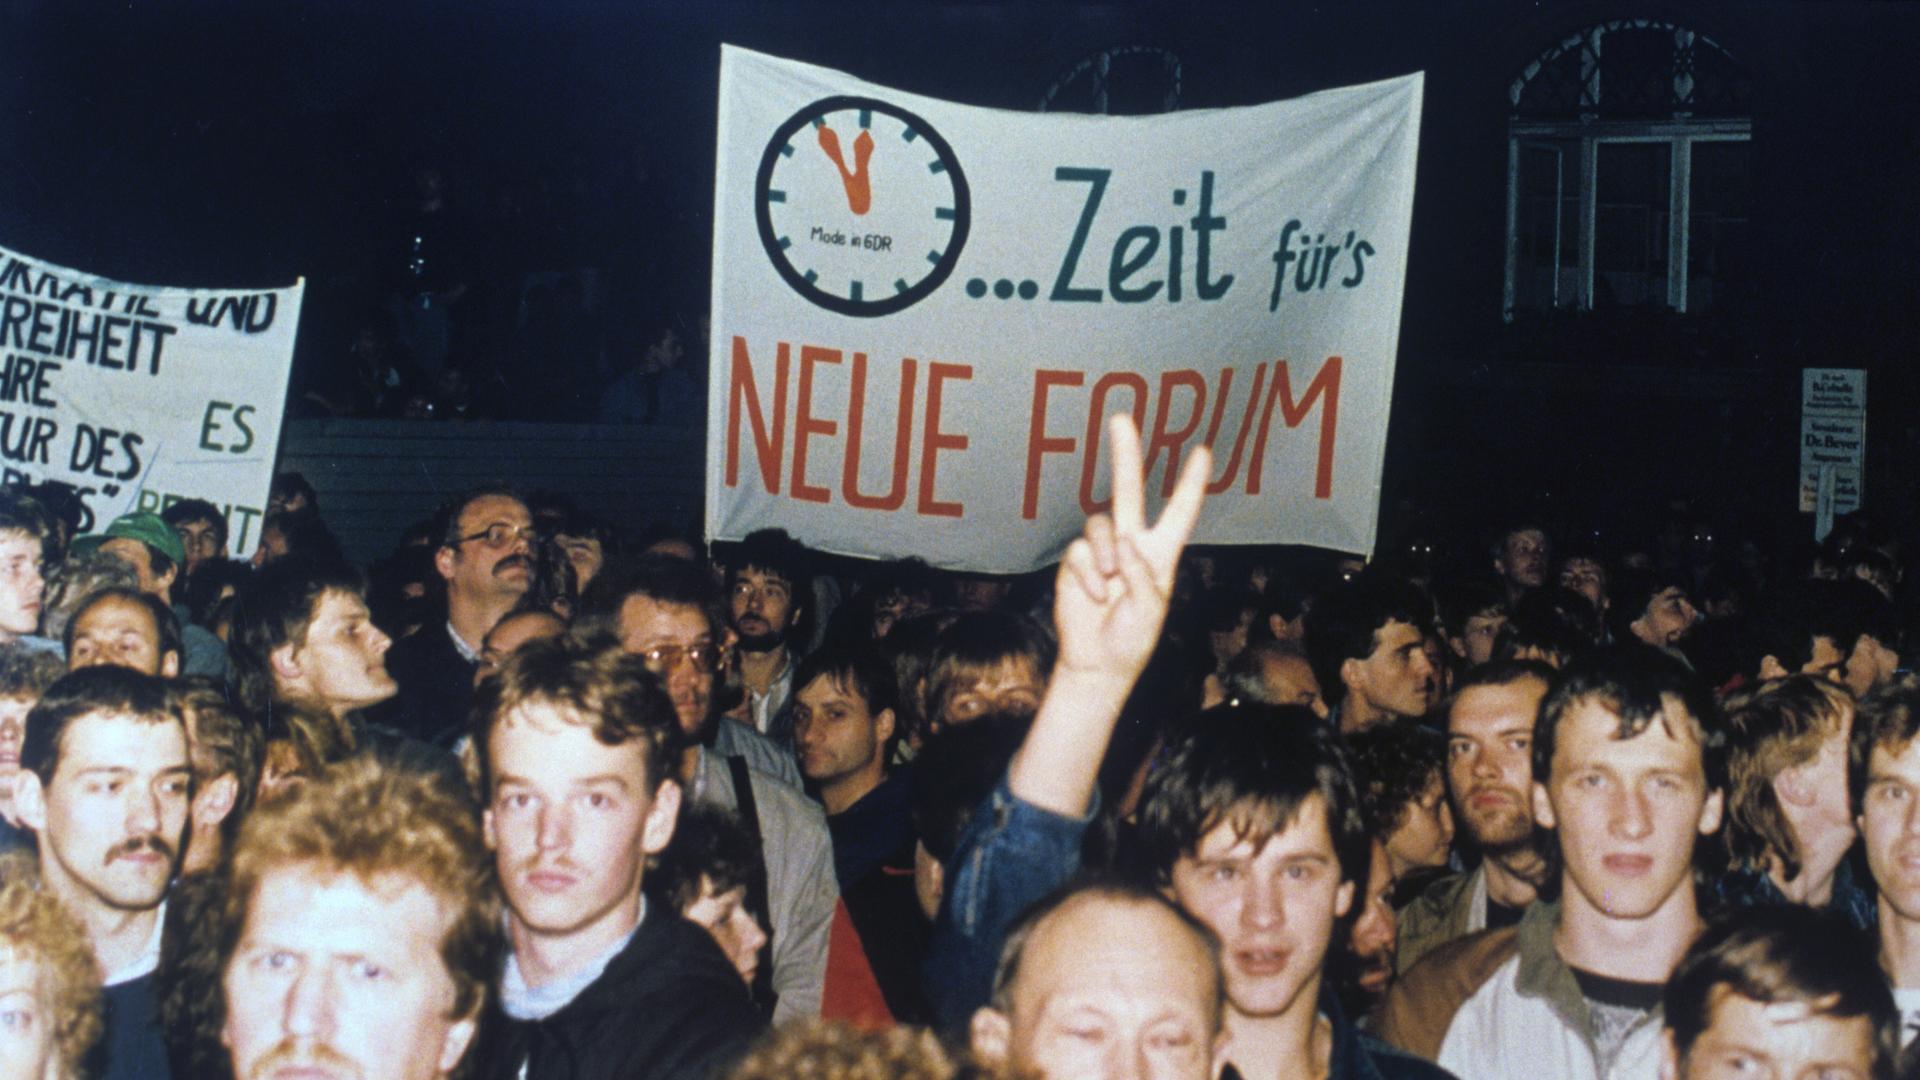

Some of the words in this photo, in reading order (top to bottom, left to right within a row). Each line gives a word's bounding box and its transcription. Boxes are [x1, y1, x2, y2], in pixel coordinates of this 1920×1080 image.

[850, 234, 862, 248] in
[1268, 219, 1376, 313] für's
[0, 293, 178, 376] REIHEIT
[185, 292, 278, 334] UND
[0, 411, 58, 465] UR
[69, 422, 144, 481] DES
[199, 401, 256, 453] ES
[726, 336, 972, 517] NEUE
[1022, 356, 1342, 520] FORUM
